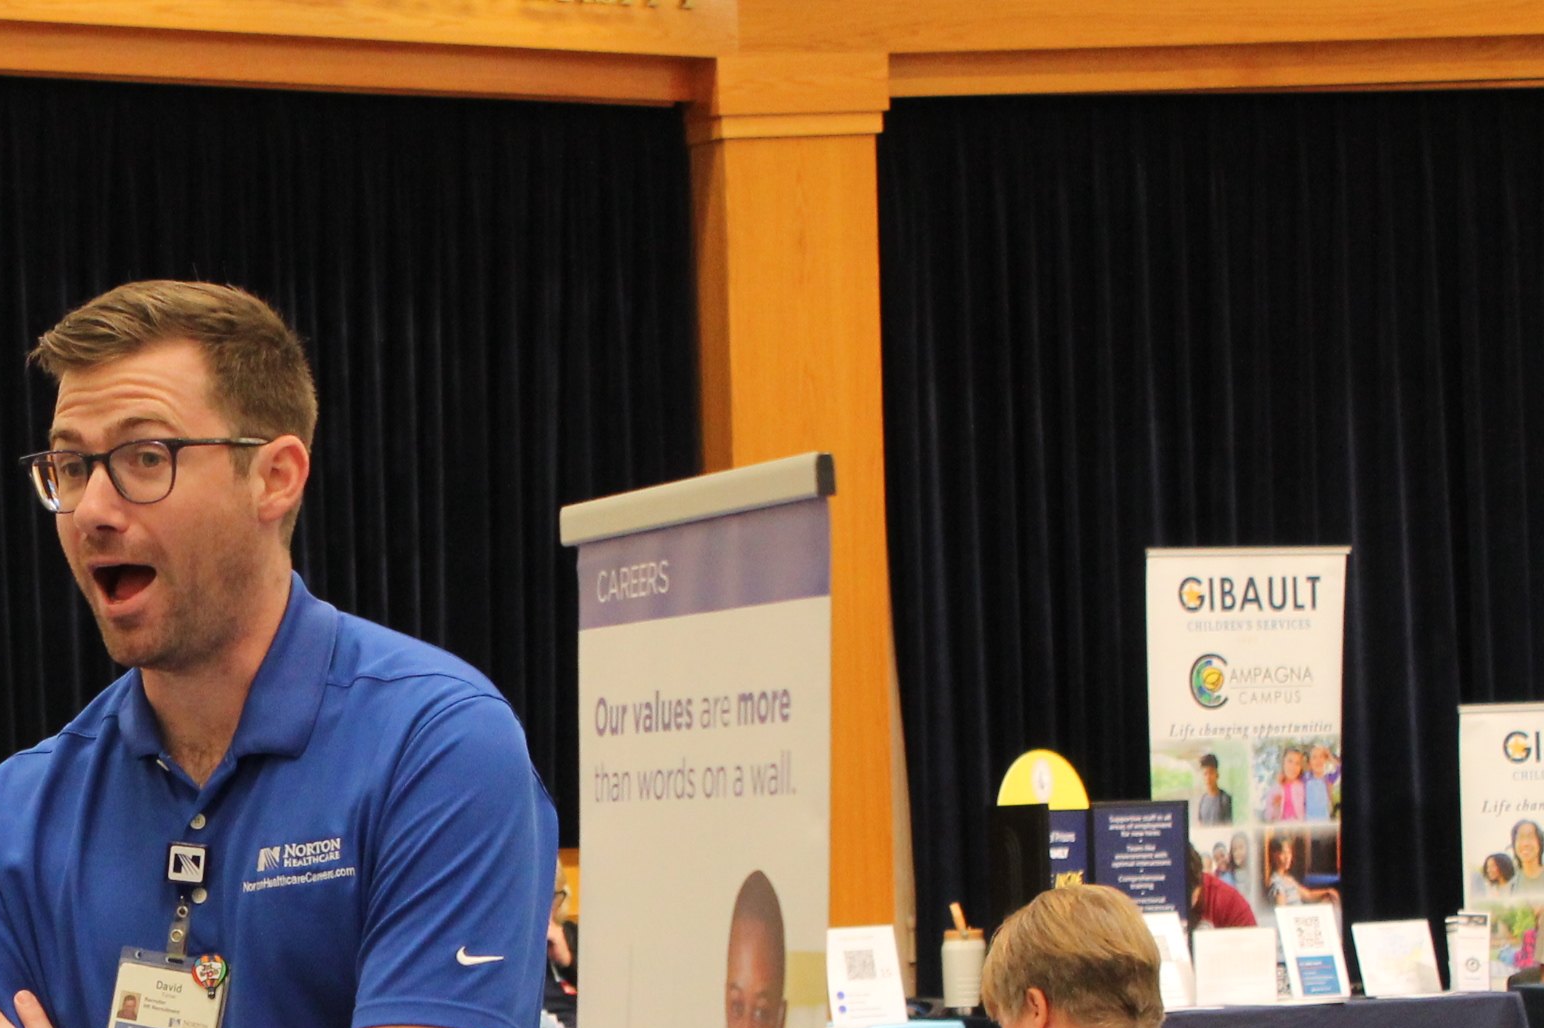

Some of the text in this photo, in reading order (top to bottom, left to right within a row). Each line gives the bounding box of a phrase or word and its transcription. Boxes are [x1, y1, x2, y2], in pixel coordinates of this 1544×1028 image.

[596, 559, 670, 604] CAREERS
[1178, 575, 1321, 613] GIBAULT
[1187, 619, 1311, 632] CHILDREN'S SERVICES
[1239, 691, 1302, 705] CAMPUS
[594, 688, 791, 737] Our values are more
[1169, 722, 1333, 742] Life changing opportunities
[594, 749, 797, 803] than words on a wall.
[1482, 800, 1511, 817] Life
[283, 838, 341, 858] NORTON
[283, 851, 341, 868] HEALTHCARE
[156, 980, 182, 993] David
